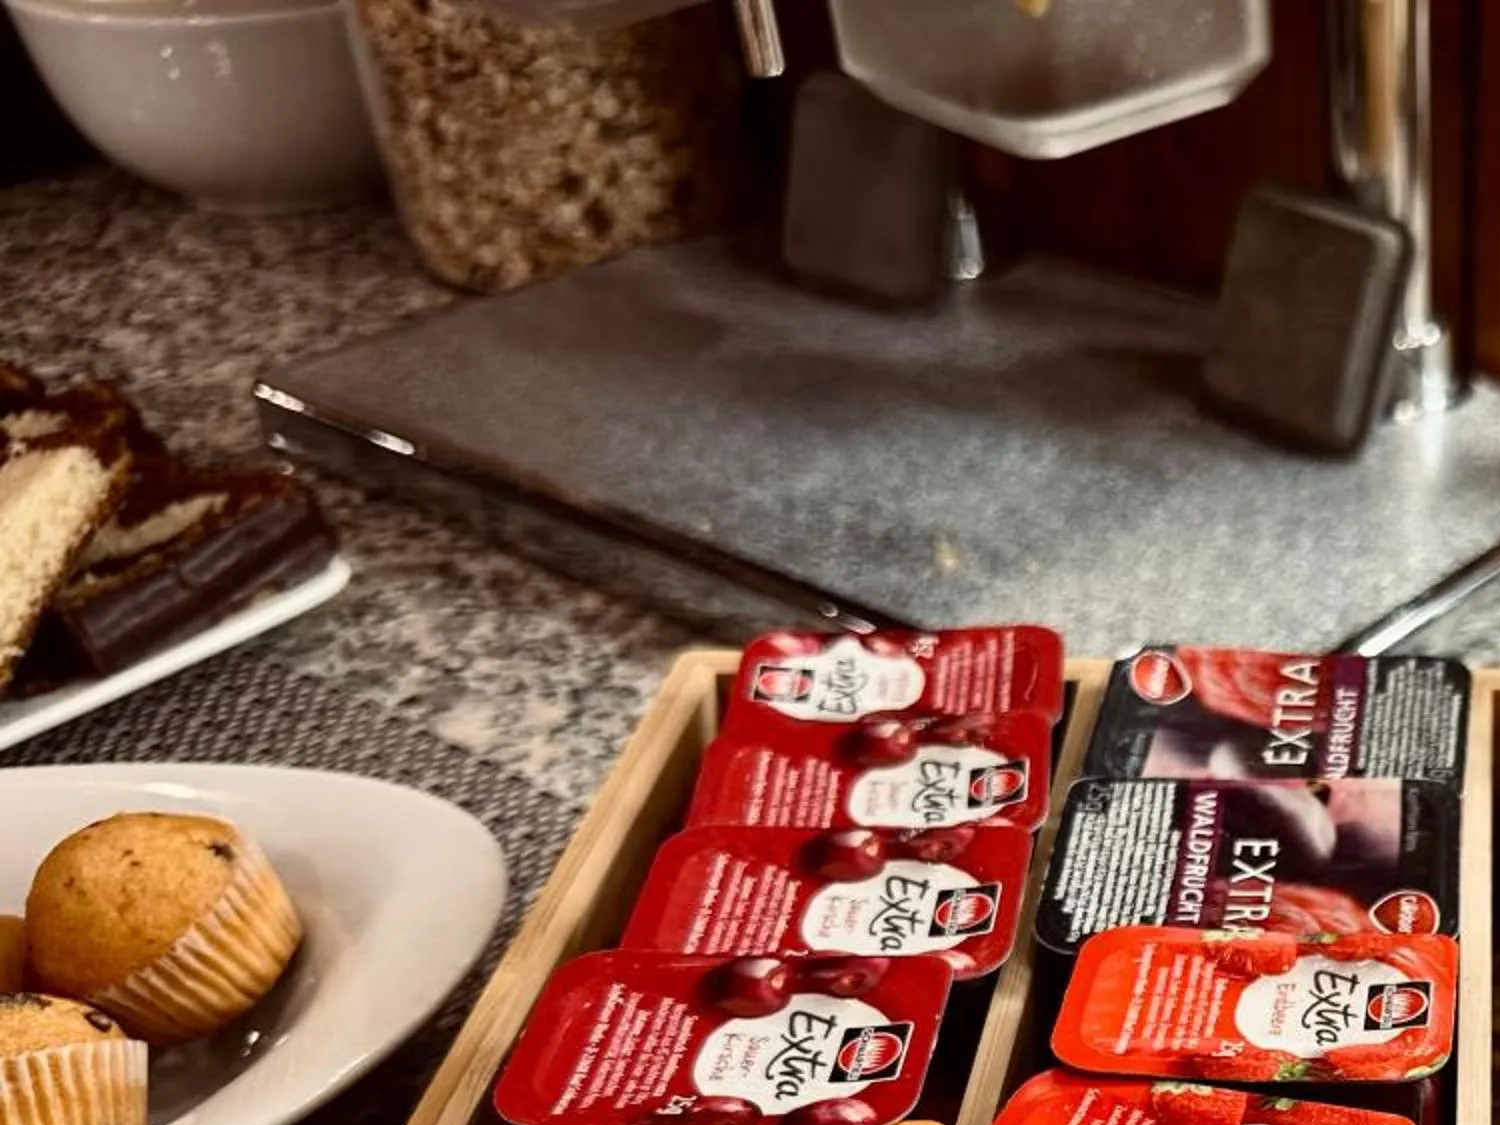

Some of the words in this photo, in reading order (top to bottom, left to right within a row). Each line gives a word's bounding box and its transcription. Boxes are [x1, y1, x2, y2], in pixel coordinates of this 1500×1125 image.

[816, 658, 870, 714] Extra
[1262, 658, 1320, 767] EXTRA
[912, 759, 961, 823] Extra
[1177, 791, 1219, 925] WALDFRUCHT
[868, 875, 930, 952] Extra
[1300, 969, 1360, 1045] Extra
[765, 1009, 839, 1100] Extra
